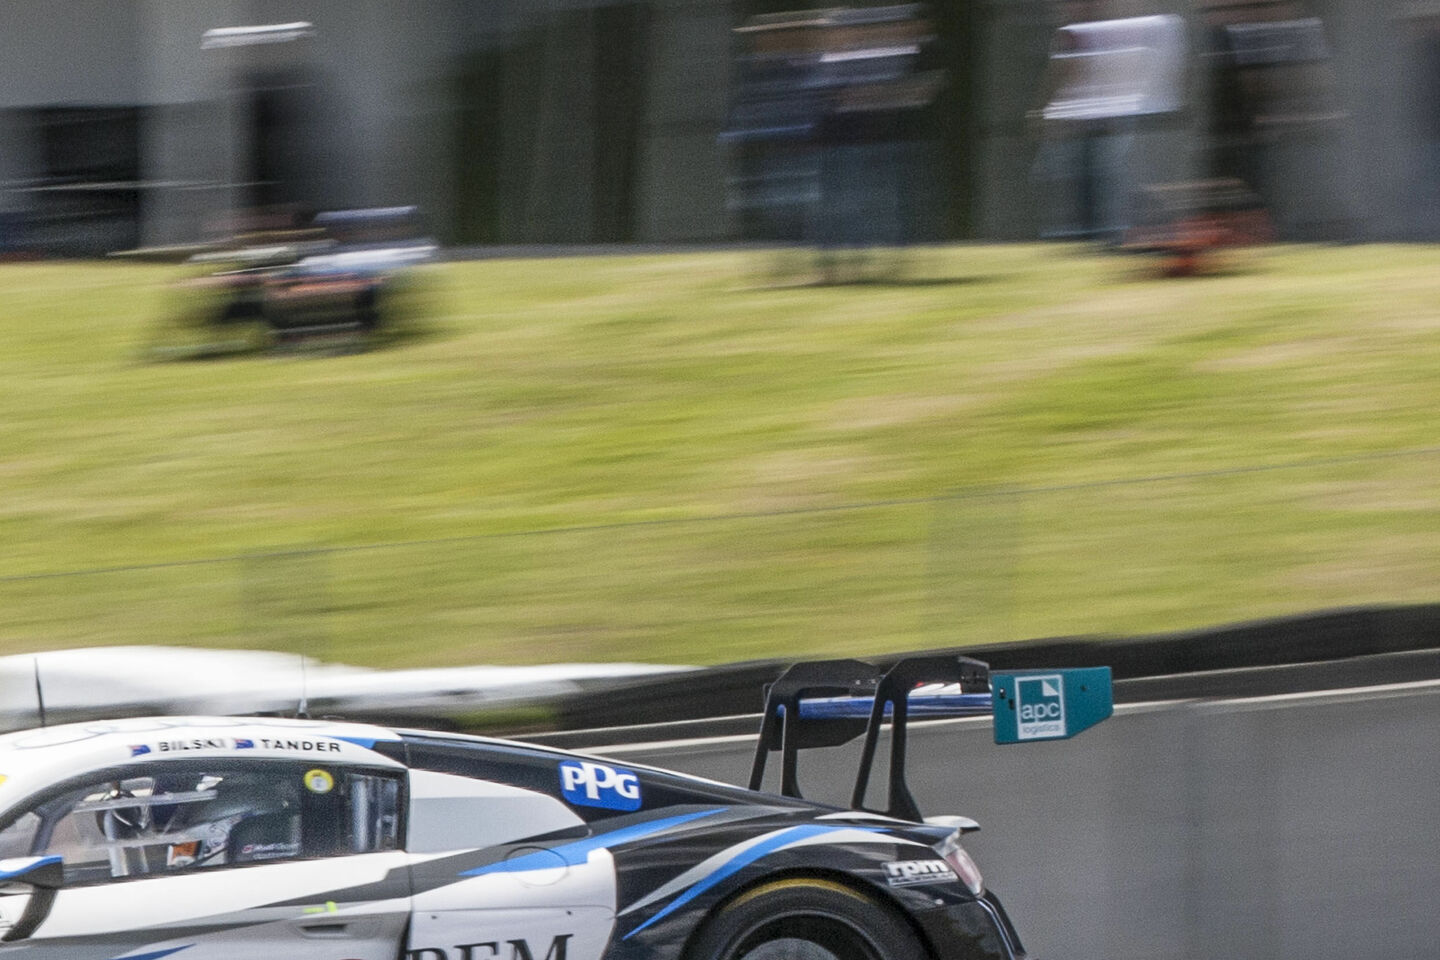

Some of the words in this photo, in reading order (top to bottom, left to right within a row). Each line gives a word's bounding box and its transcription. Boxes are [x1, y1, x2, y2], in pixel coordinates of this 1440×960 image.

[1021, 702, 1060, 722] apc
[260, 739, 341, 752] TANDER
[561, 762, 640, 800] PPG
[887, 861, 948, 878] rpm
